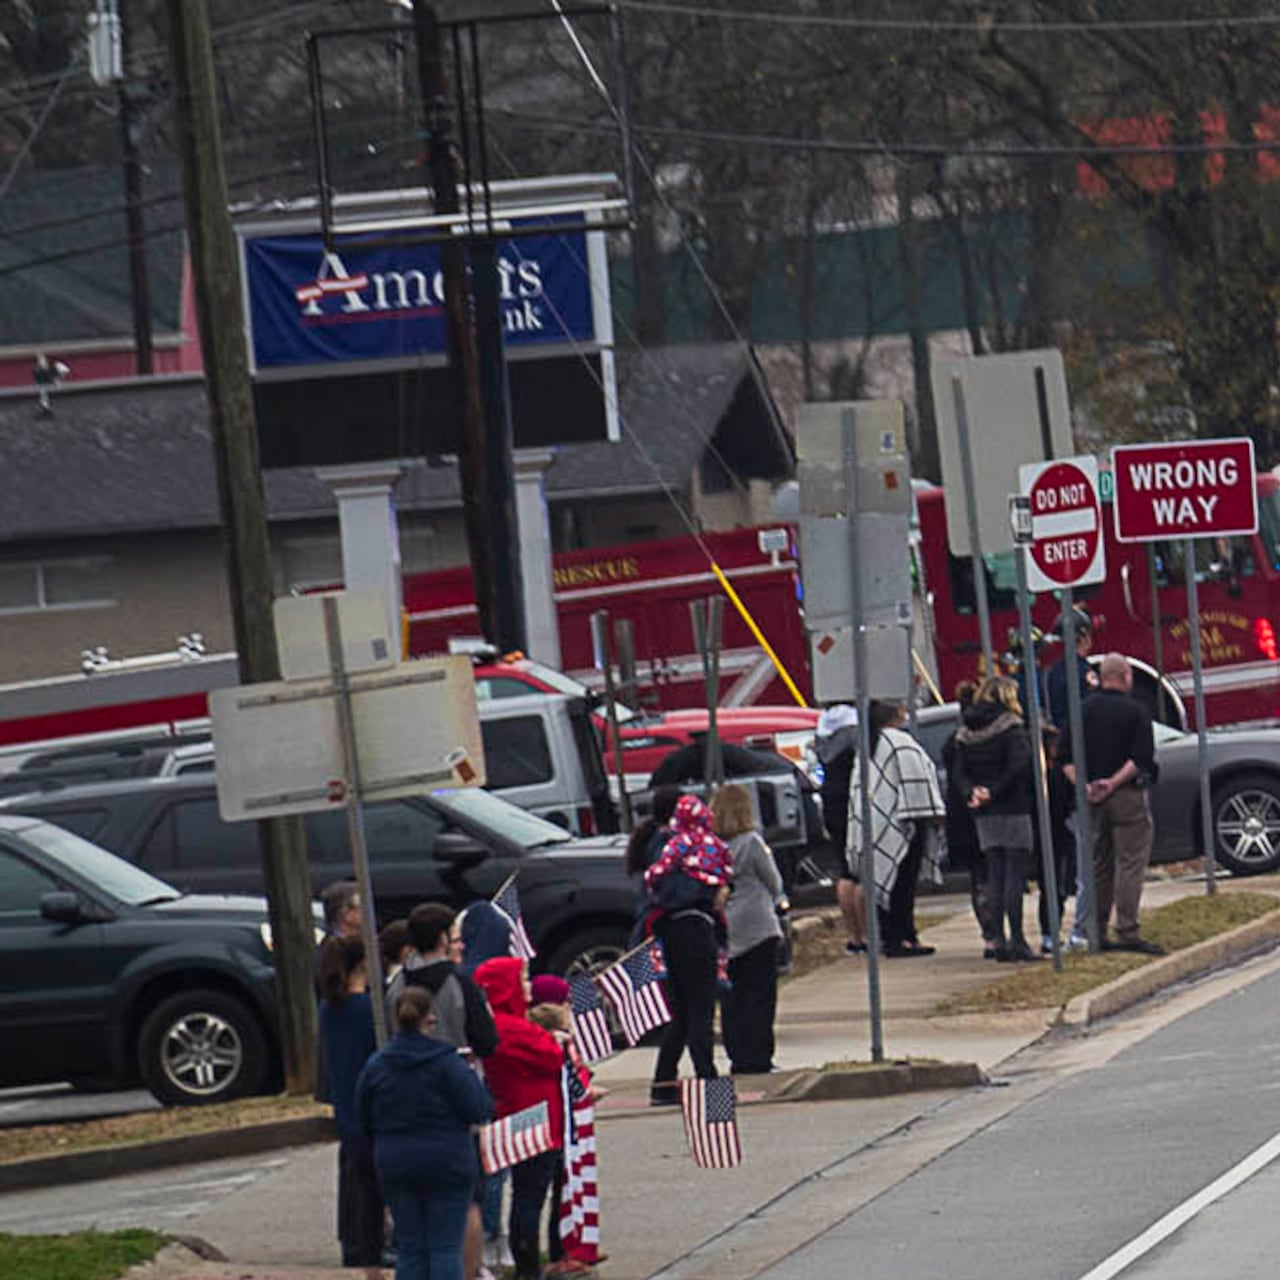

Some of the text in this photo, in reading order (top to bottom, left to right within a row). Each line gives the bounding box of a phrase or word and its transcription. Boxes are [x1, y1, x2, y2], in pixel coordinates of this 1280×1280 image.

[1129, 458, 1239, 492] WRONG
[1035, 483, 1087, 511] DO NOT
[1152, 495, 1219, 526] WAY
[1043, 538, 1089, 564] ENTER
[553, 558, 639, 586] RESCUE
